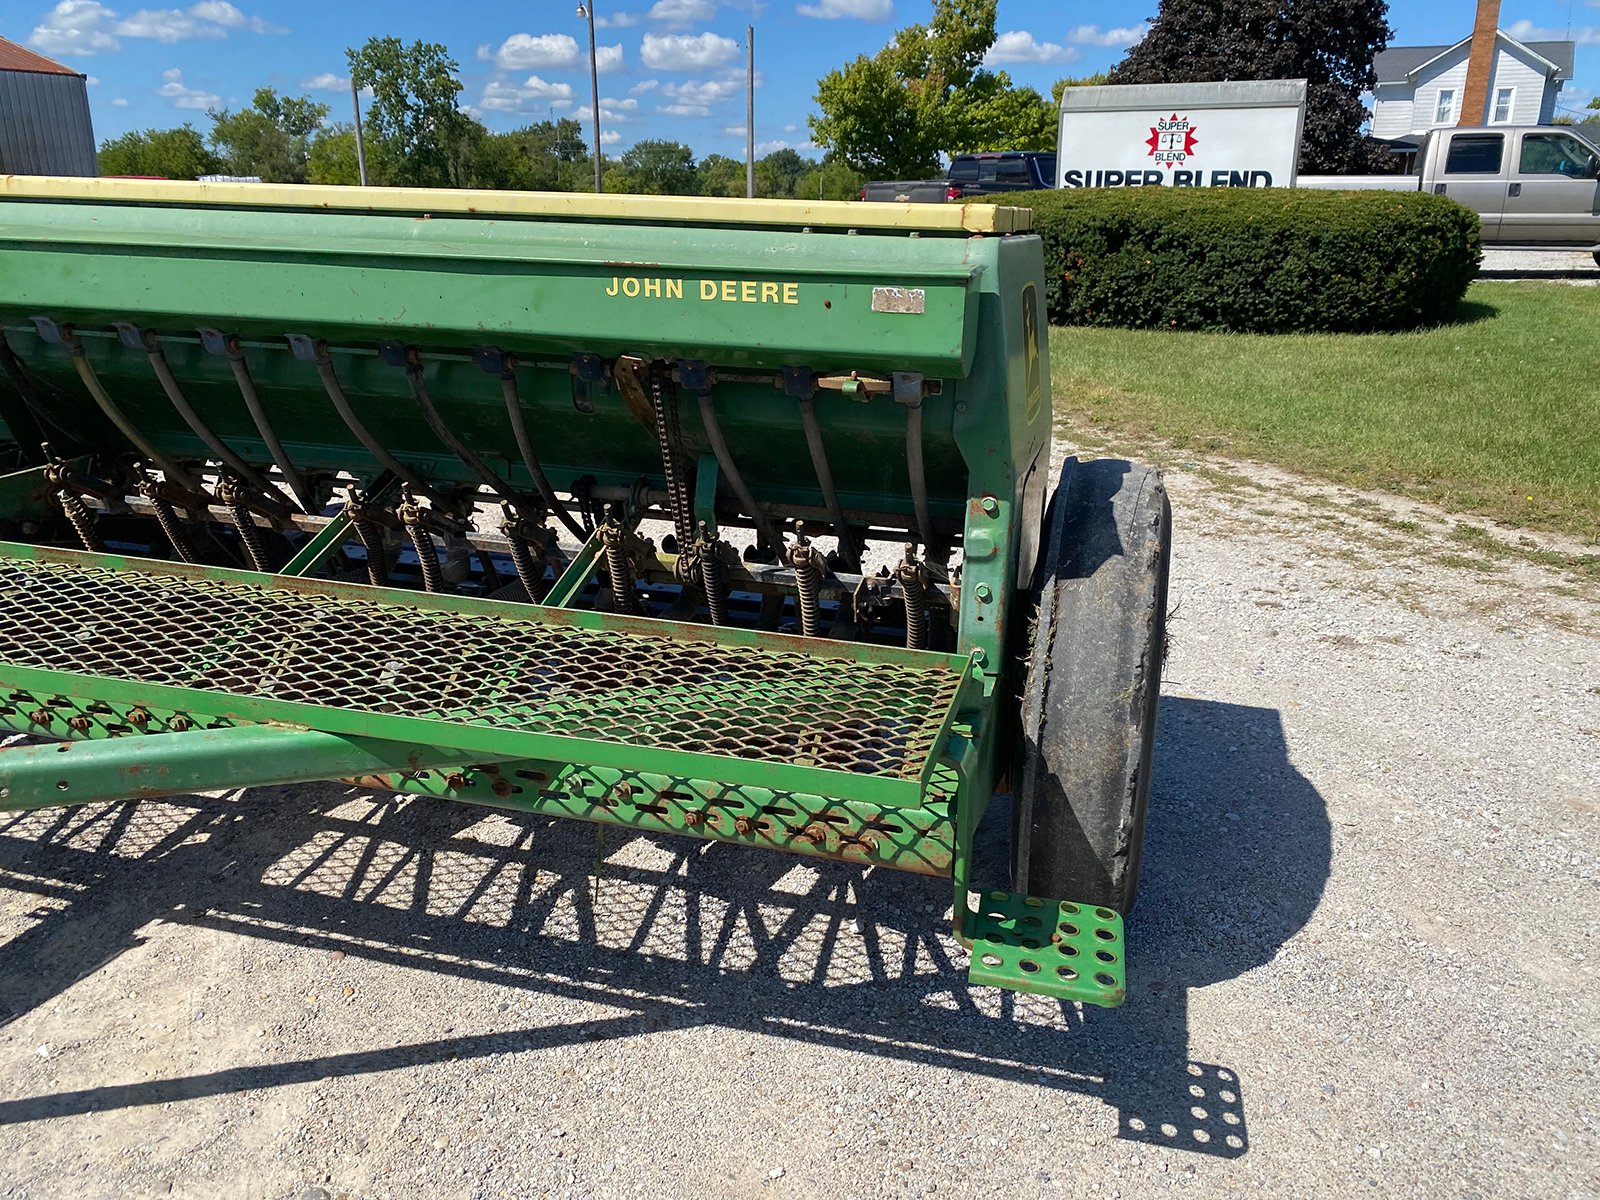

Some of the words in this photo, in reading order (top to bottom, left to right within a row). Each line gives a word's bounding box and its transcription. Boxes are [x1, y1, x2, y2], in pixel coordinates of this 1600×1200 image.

[1158, 121, 1189, 130] SUPER
[1155, 152, 1186, 161] BLEND
[1064, 170, 1163, 188] SUPER
[605, 276, 683, 299] JOHN
[699, 279, 799, 304] DEERE
